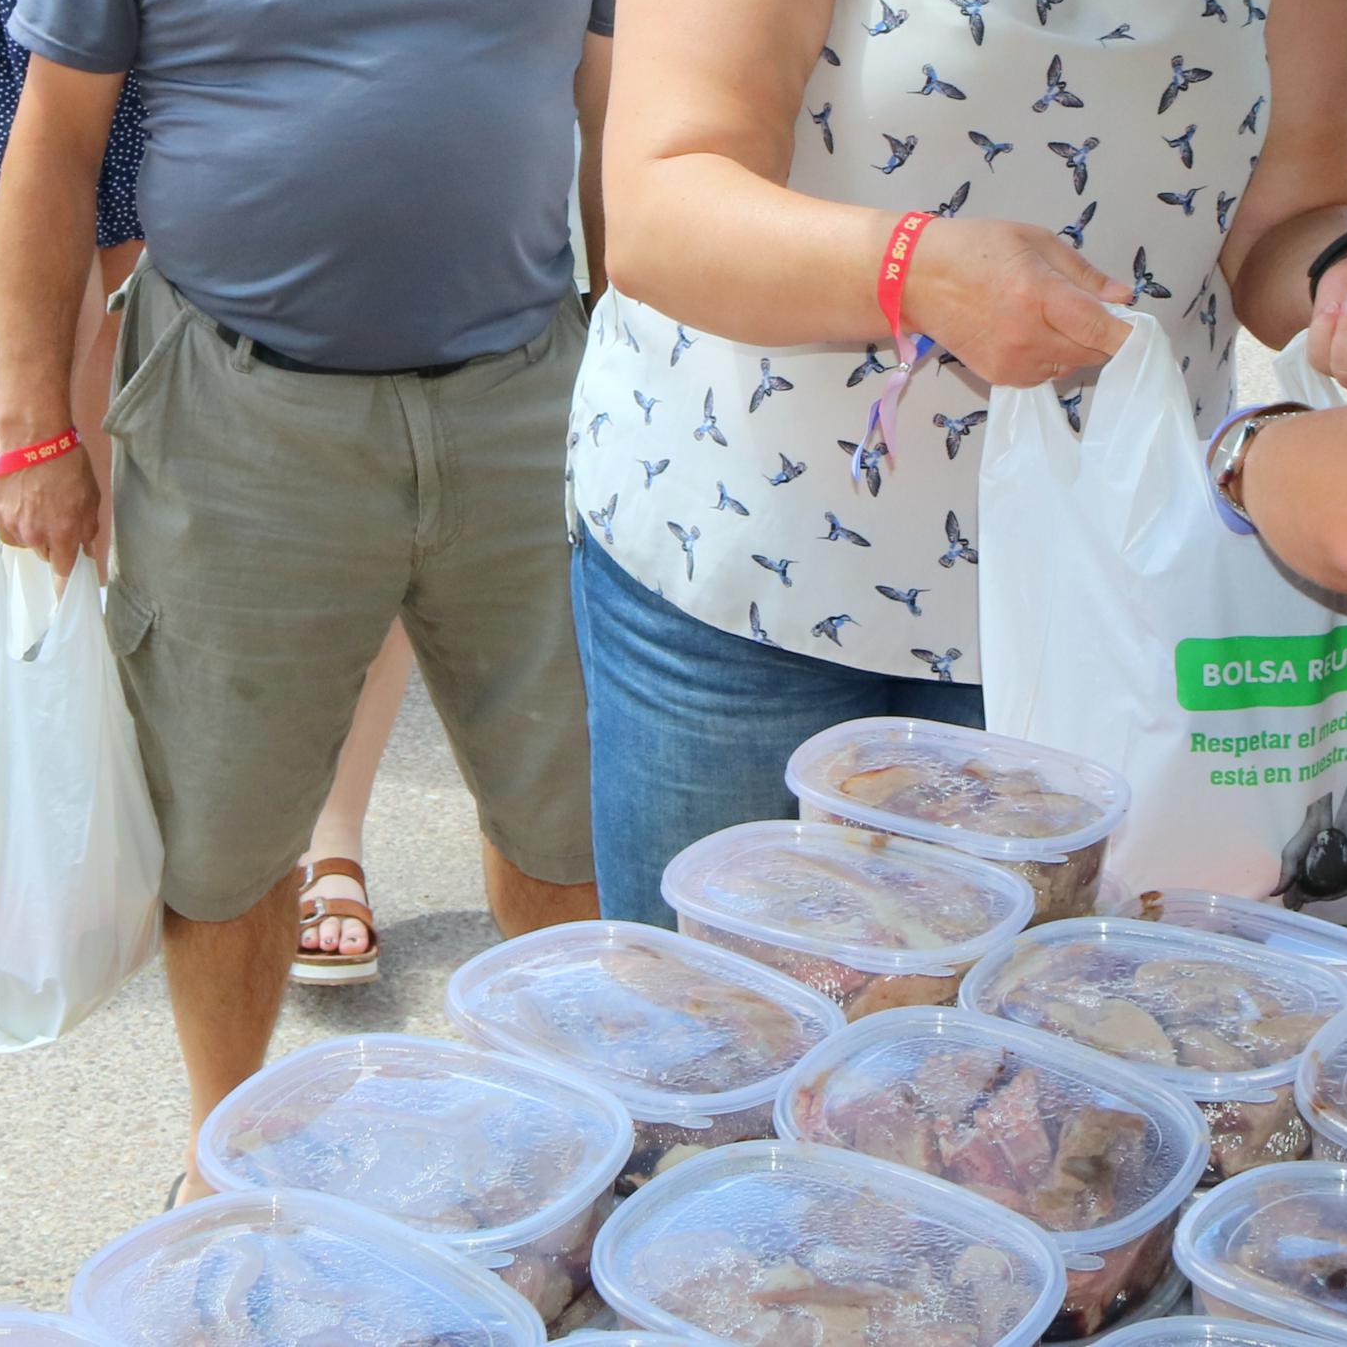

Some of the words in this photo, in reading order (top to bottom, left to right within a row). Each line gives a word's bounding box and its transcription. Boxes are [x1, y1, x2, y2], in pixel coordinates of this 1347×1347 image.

[904, 216, 923, 231] DE
[892, 232, 911, 261] SOY
[884, 262, 901, 280] YO
[23, 450, 38, 463] YO
[38, 442, 57, 458] SOY
[1202, 659, 1298, 687] BOLSA
[1190, 730, 1292, 758] Respetar
[1297, 726, 1316, 749] el
[1210, 765, 1258, 786] está
[1263, 766, 1292, 784] en
